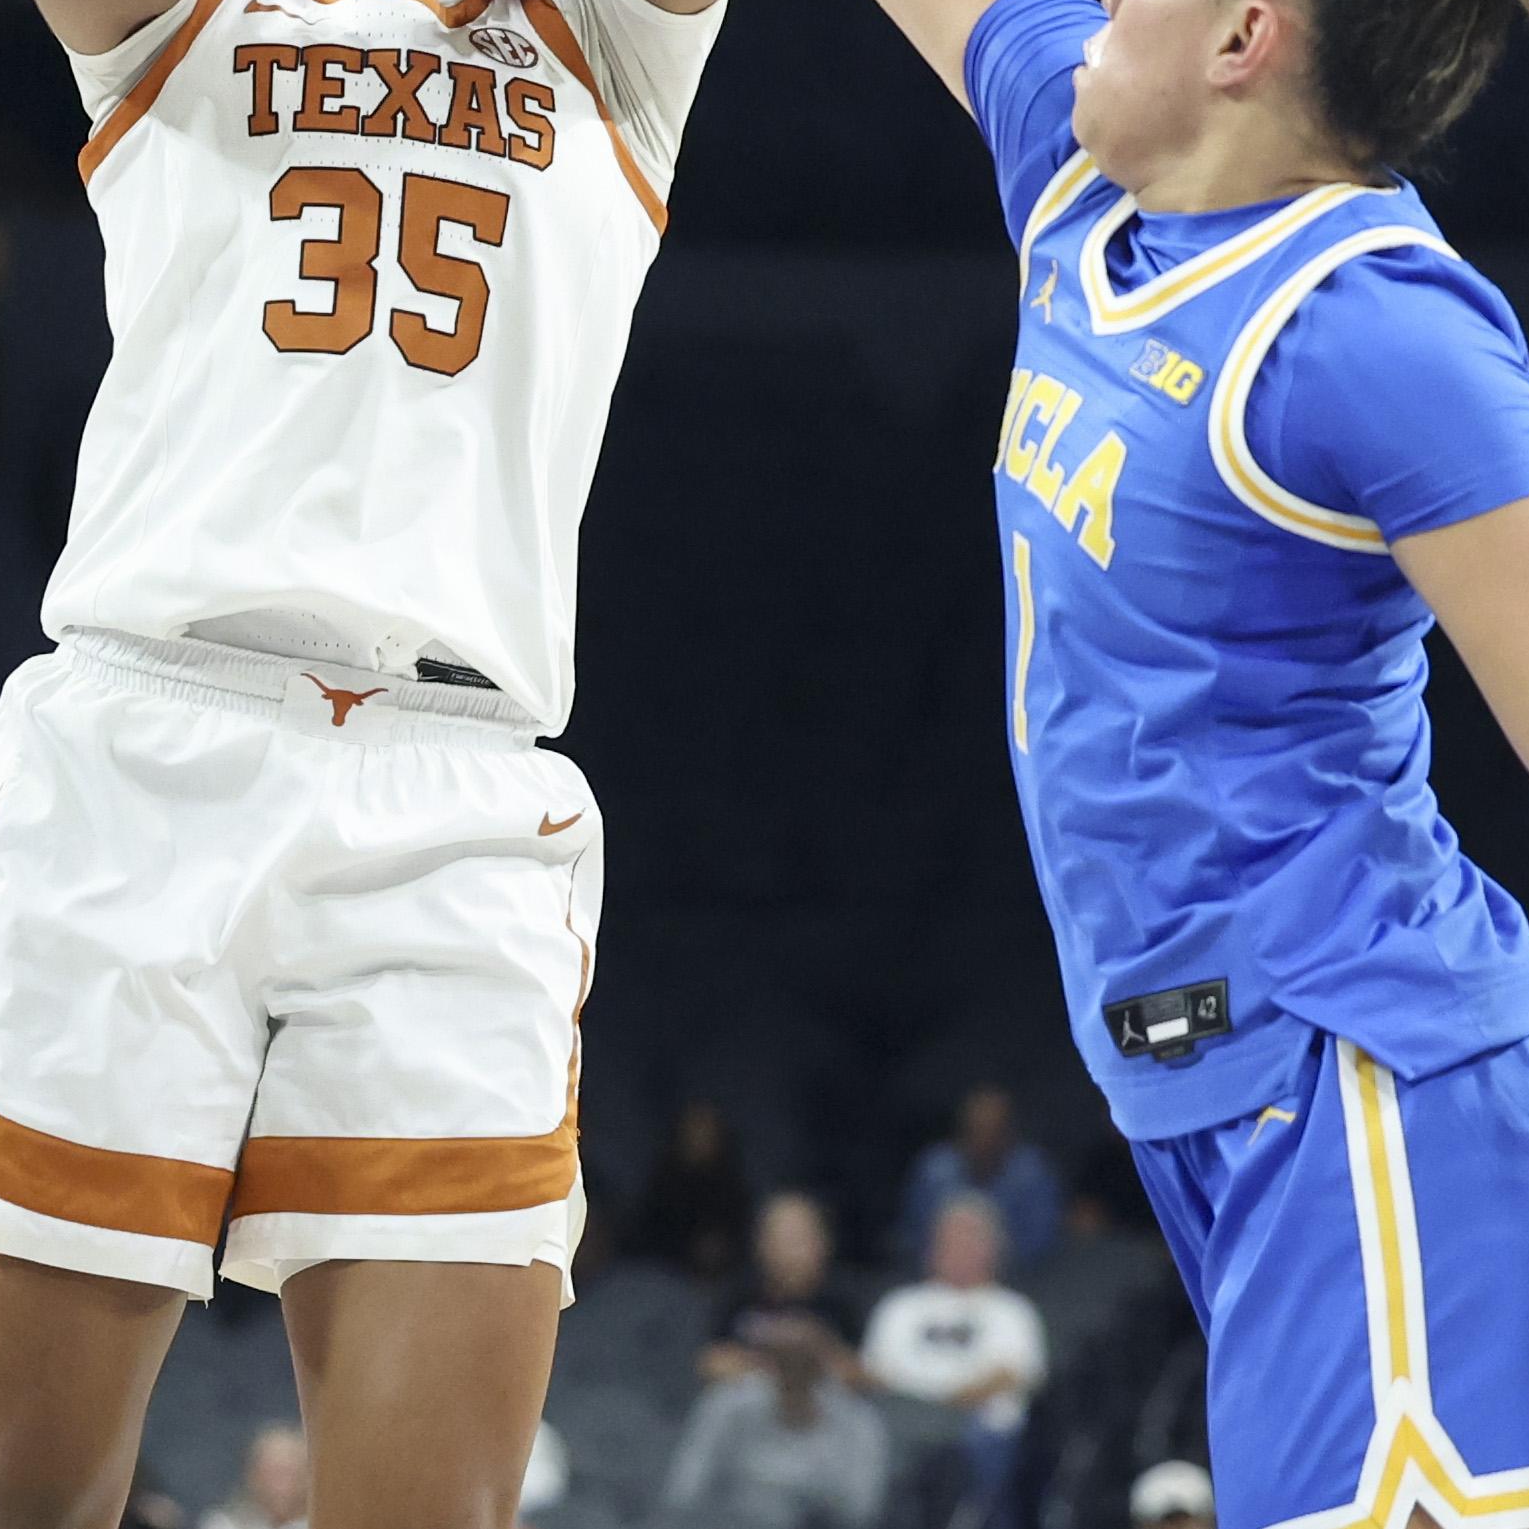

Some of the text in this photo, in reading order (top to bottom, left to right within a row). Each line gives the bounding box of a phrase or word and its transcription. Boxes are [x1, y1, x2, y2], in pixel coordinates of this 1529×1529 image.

[470, 28, 539, 69] SEC
[233, 43, 555, 171] TEXAS
[261, 166, 511, 378] 35
[1197, 995, 1218, 1020] 42
